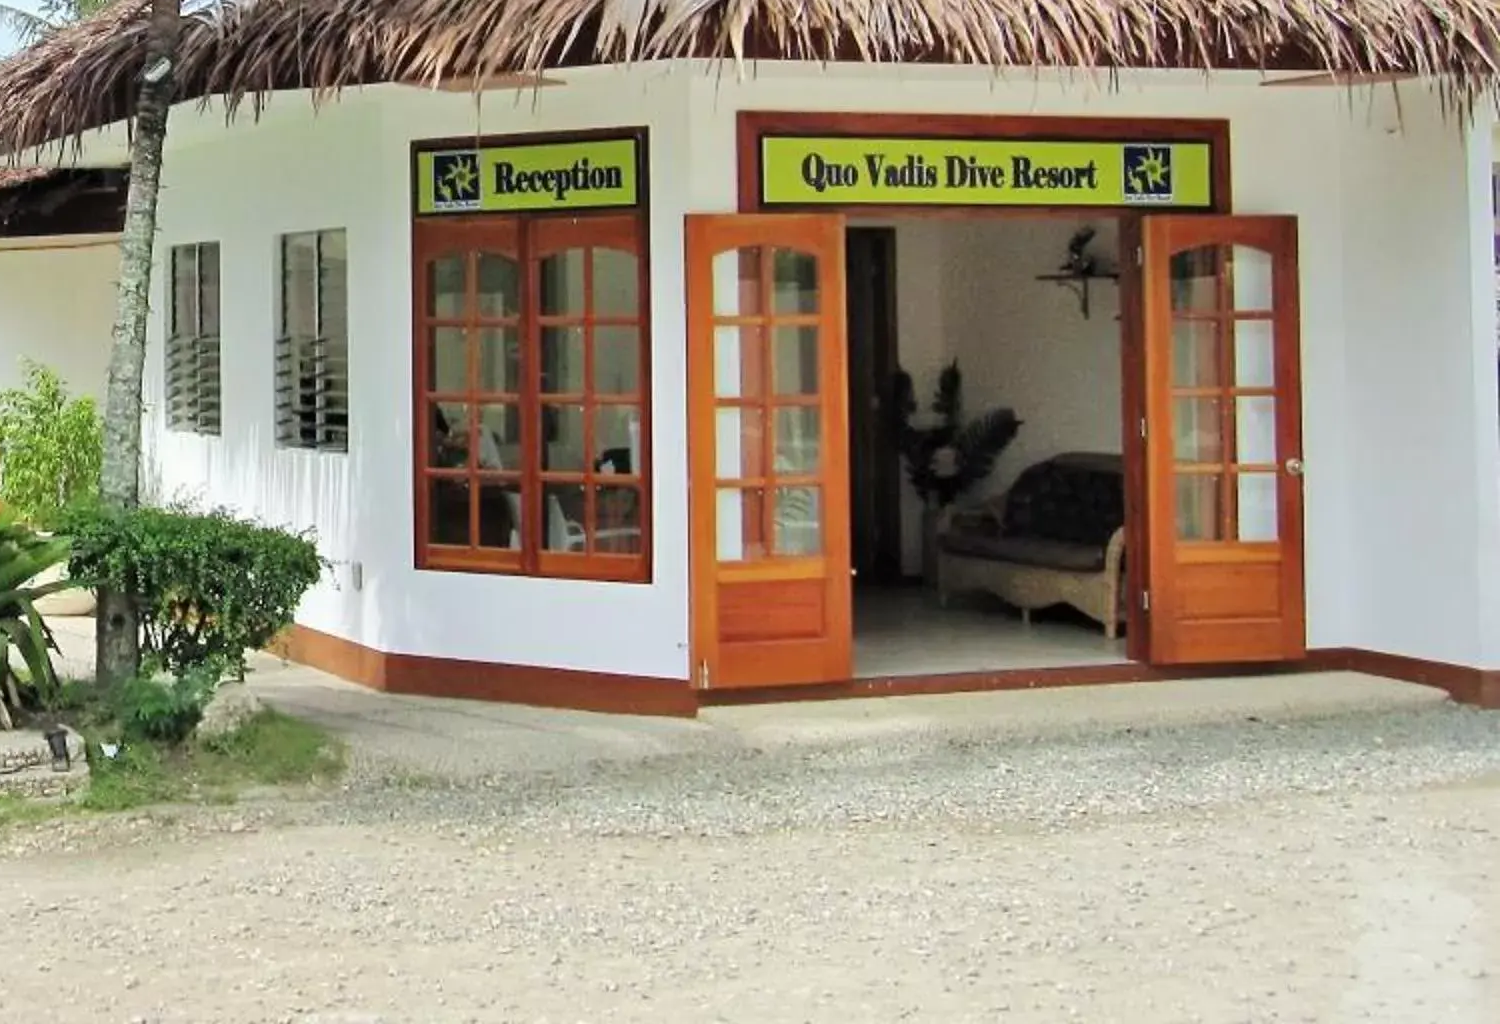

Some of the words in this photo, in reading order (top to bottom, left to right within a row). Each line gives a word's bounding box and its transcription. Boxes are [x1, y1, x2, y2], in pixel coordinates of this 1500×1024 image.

[493, 157, 623, 200] Reception
[801, 152, 859, 192] Quo
[863, 154, 938, 188] Vadis
[945, 155, 1005, 188] Dive
[1011, 156, 1098, 189] Resort
